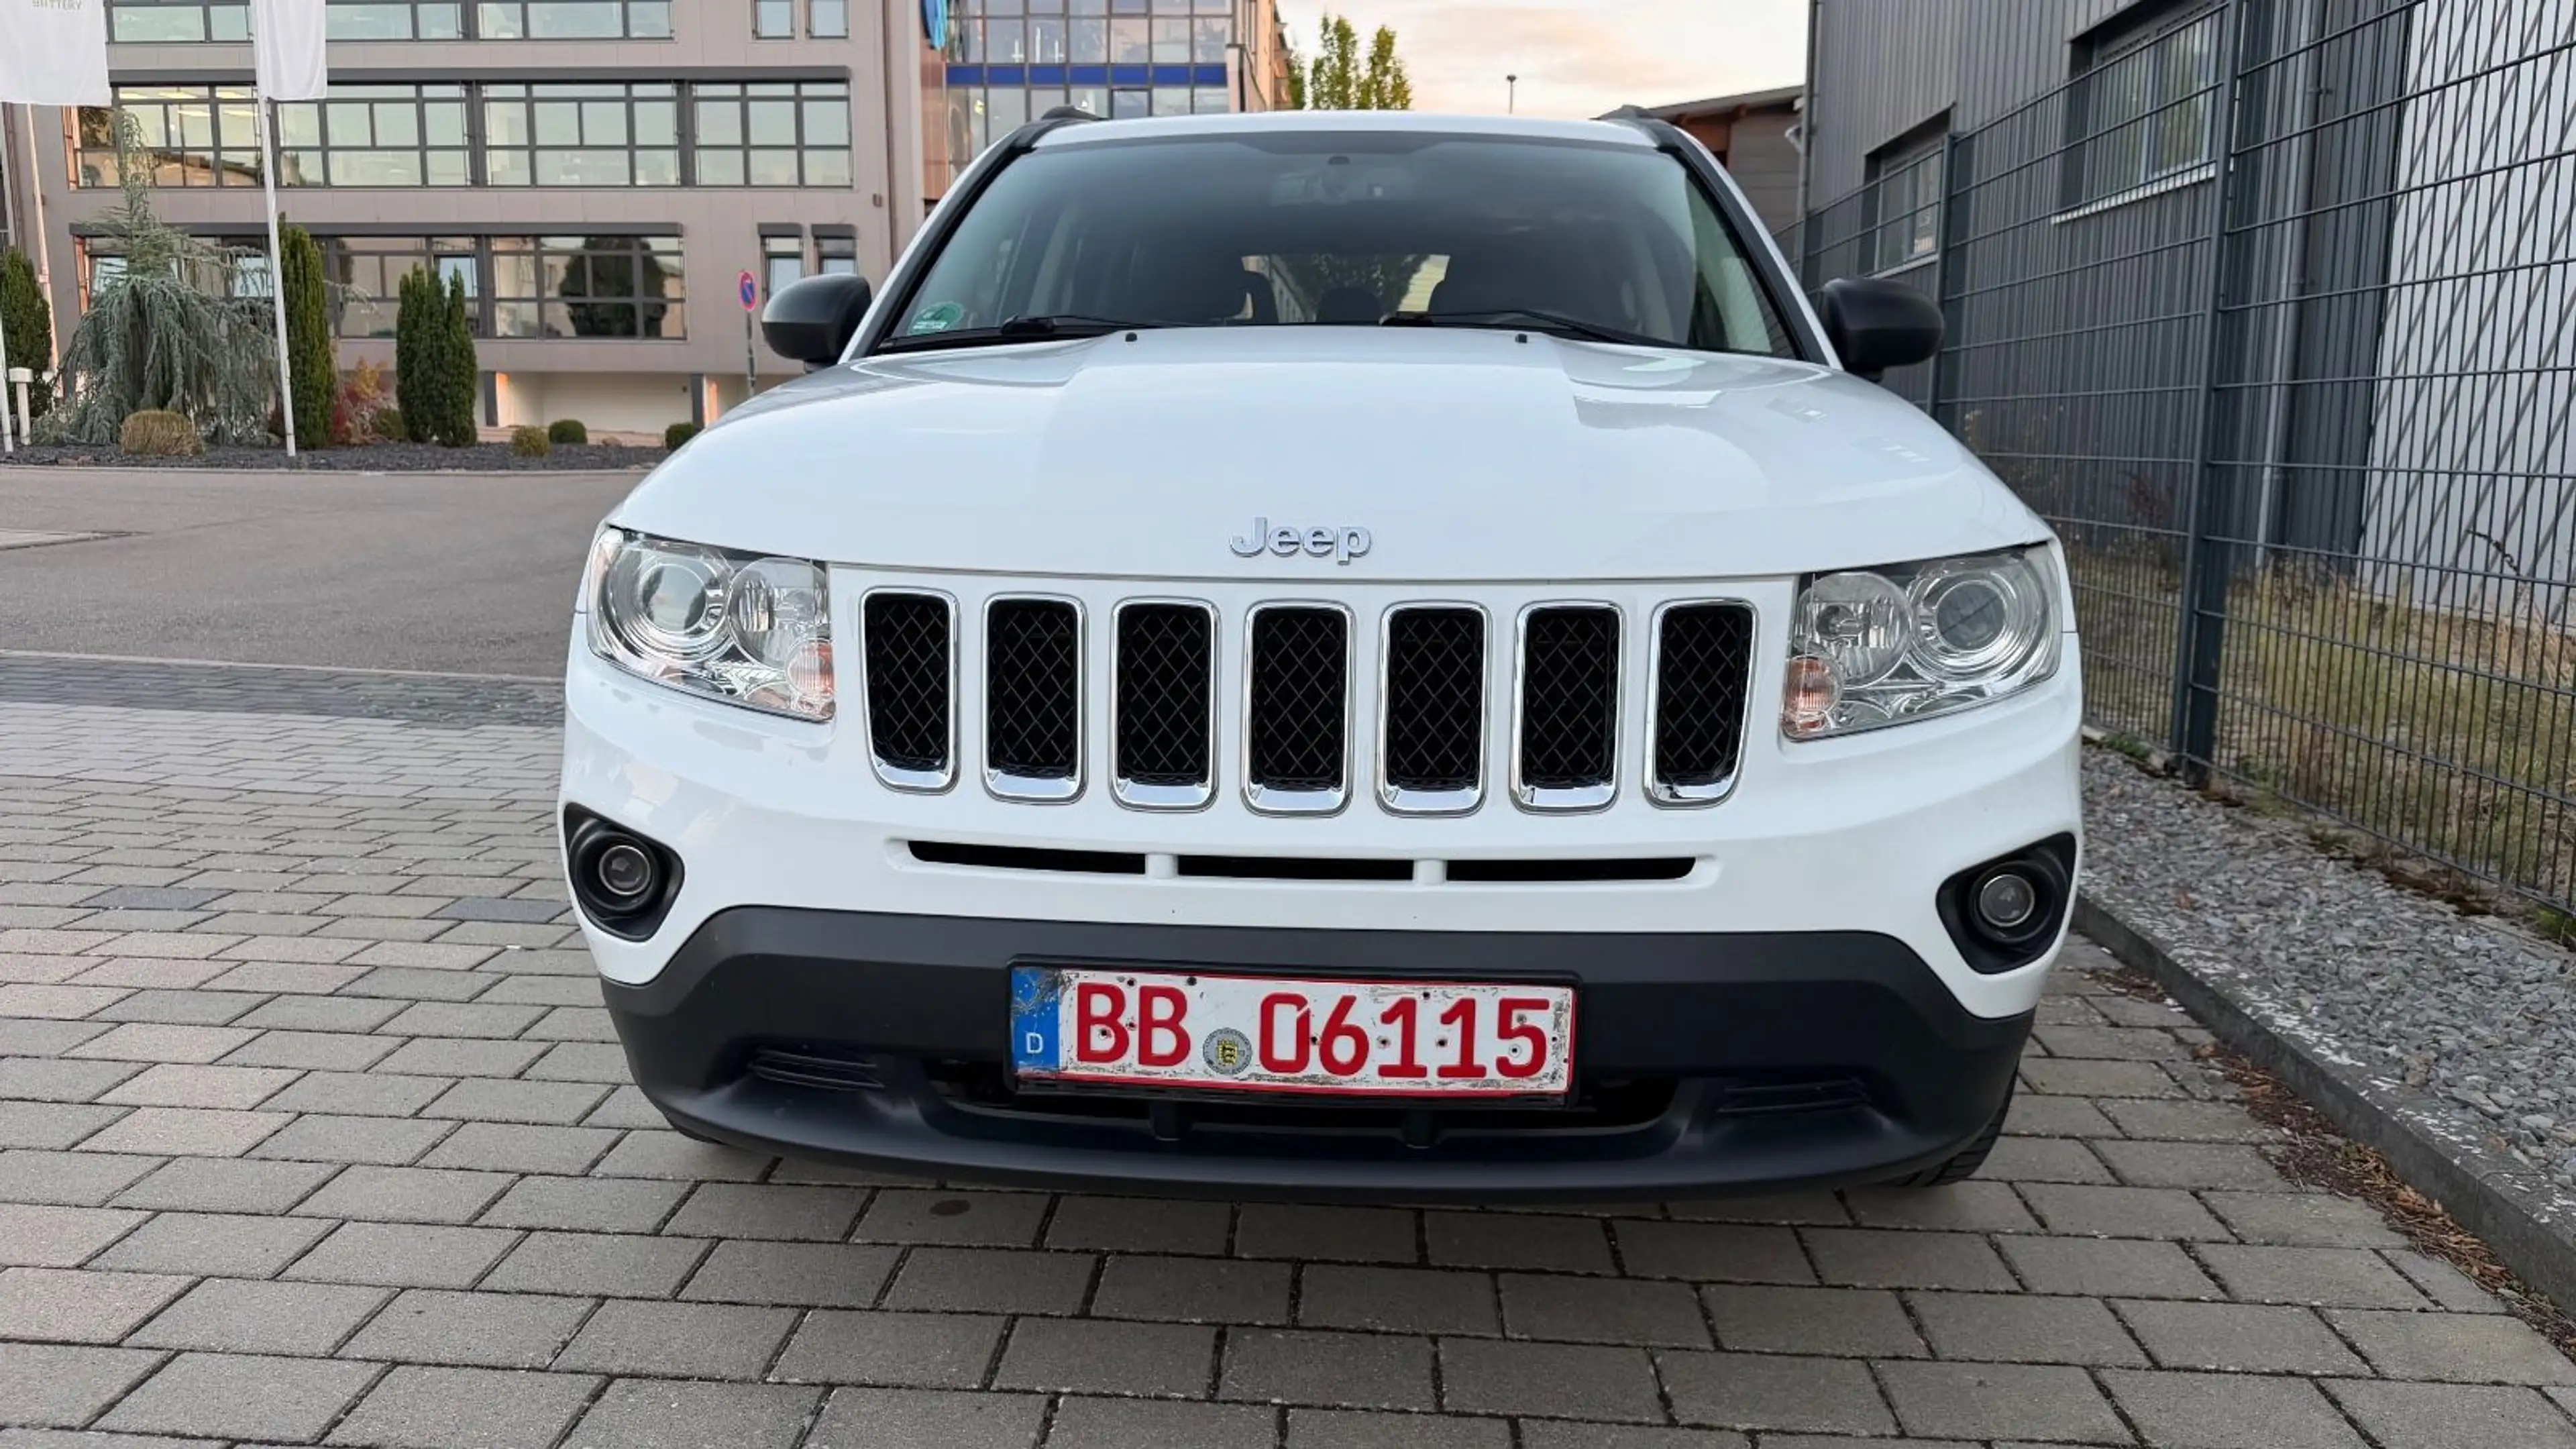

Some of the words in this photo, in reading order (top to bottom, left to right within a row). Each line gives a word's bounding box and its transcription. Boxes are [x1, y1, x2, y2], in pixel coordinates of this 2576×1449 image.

[1229, 517, 1372, 566] Jeep
[1026, 1032, 1044, 1054] D
[1076, 983, 1191, 1067] BB
[1258, 993, 1550, 1079] 06115
